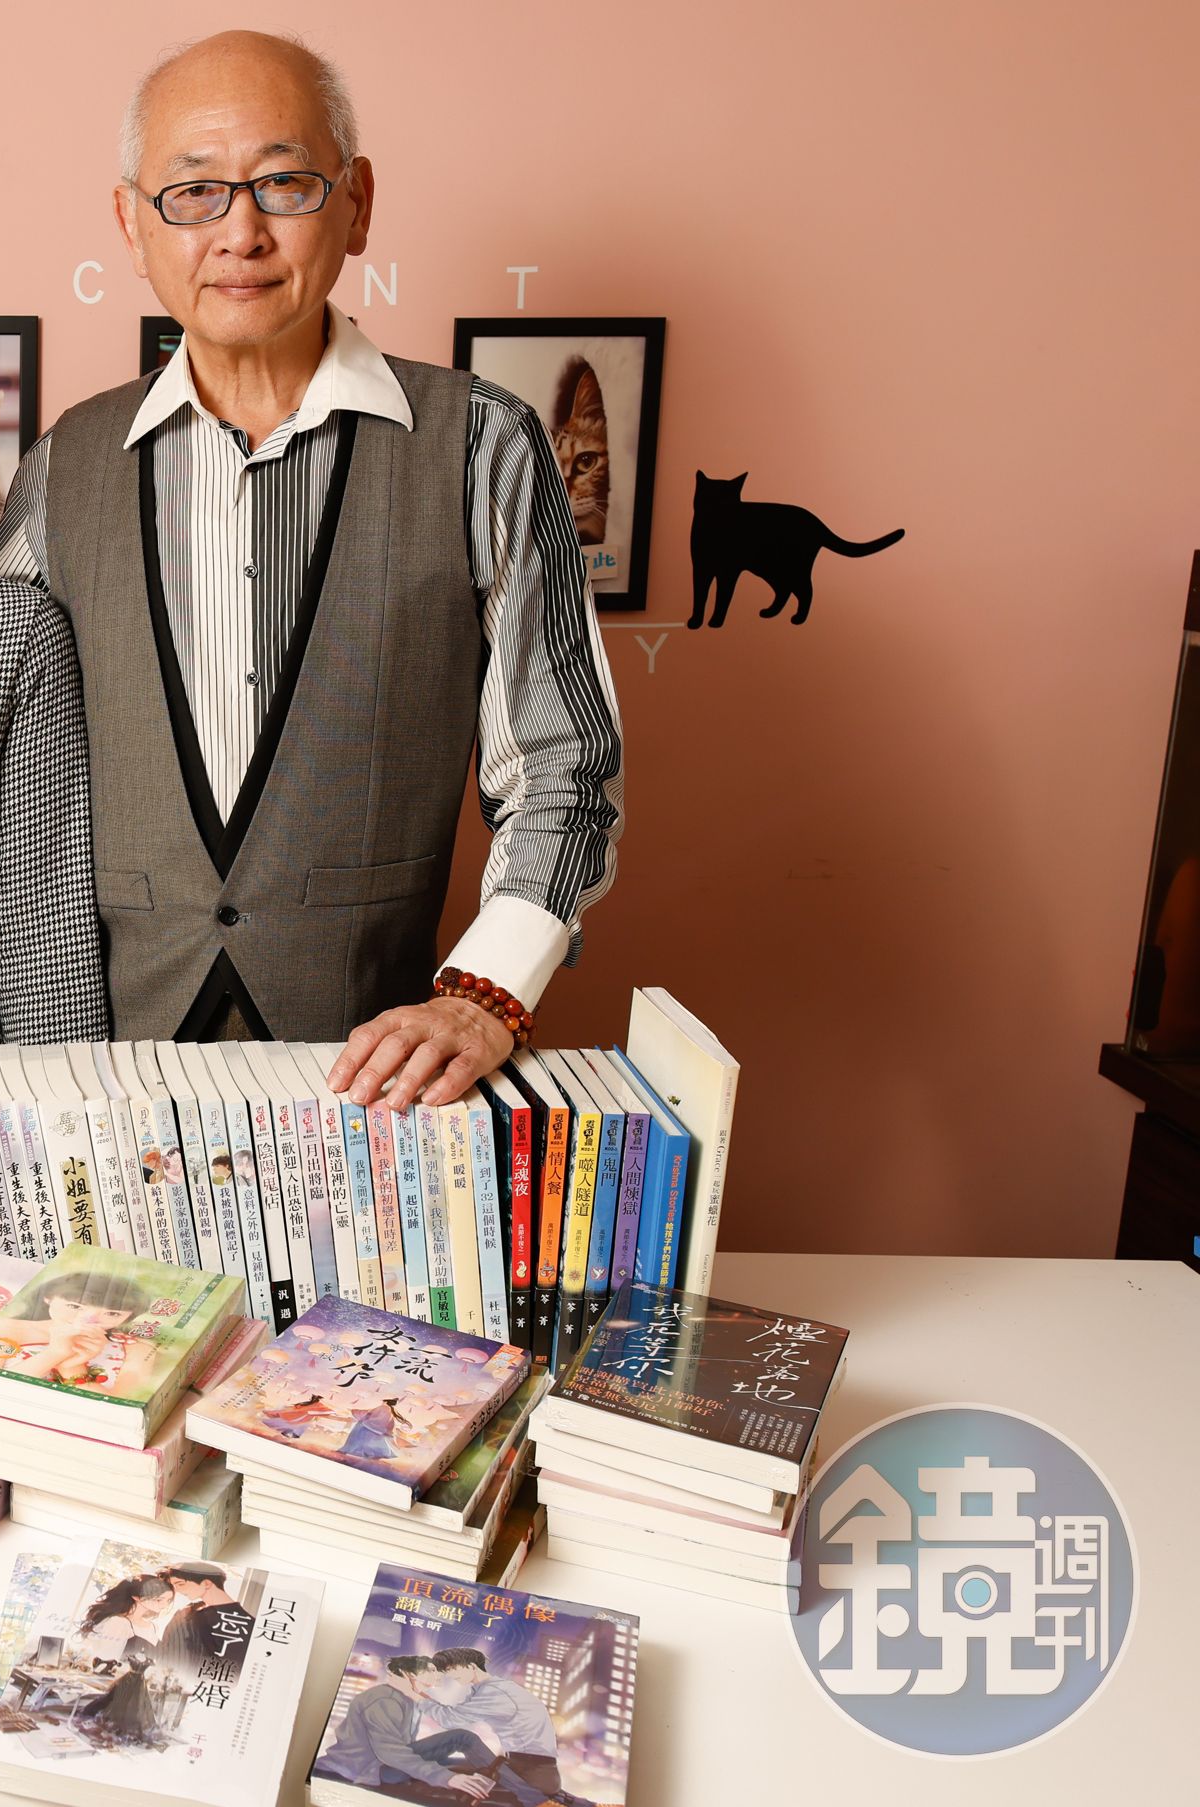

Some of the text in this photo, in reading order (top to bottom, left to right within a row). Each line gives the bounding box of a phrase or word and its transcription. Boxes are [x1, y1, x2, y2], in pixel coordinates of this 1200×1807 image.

[257, 1143, 280, 1211] 陰陽鬼店
[305, 1143, 325, 1200] 月出將臨
[328, 1145, 350, 1229] 隧道裡的亡靈
[453, 1165, 466, 1189] 暖暖
[514, 1152, 529, 1197] 勾魂夜
[547, 1151, 565, 1196] 情人餐
[574, 1158, 594, 1217] 噬人隧道
[601, 1158, 617, 1187] 鬼門
[622, 1157, 642, 1216] 人間煉獄
[713, 1145, 725, 1173] Grace
[63, 1157, 95, 1245] 小姐要有
[106, 1157, 128, 1224] 等待微光
[195, 1187, 212, 1238] 見鬼的親吻
[281, 1142, 306, 1240] 歡迎入住恐怖屋
[378, 1158, 398, 1252] 我們的初戀有時差
[402, 1159, 419, 1229] 與妳一起沉睡
[479, 1166, 497, 1249] 到了32這個時候
[219, 1187, 238, 1262] 我被勁敵標記了
[437, 1290, 450, 1321] 官敏兒
[332, 1324, 418, 1387] 女仵作
[394, 1348, 453, 1383] 一流
[730, 1317, 828, 1412] 煙花落地
[391, 1612, 443, 1632] 風夜昕
[395, 1596, 504, 1629] 翻船了
[401, 1577, 558, 1624] 頂流偶像
[191, 1609, 253, 1711] 忘了離婚
